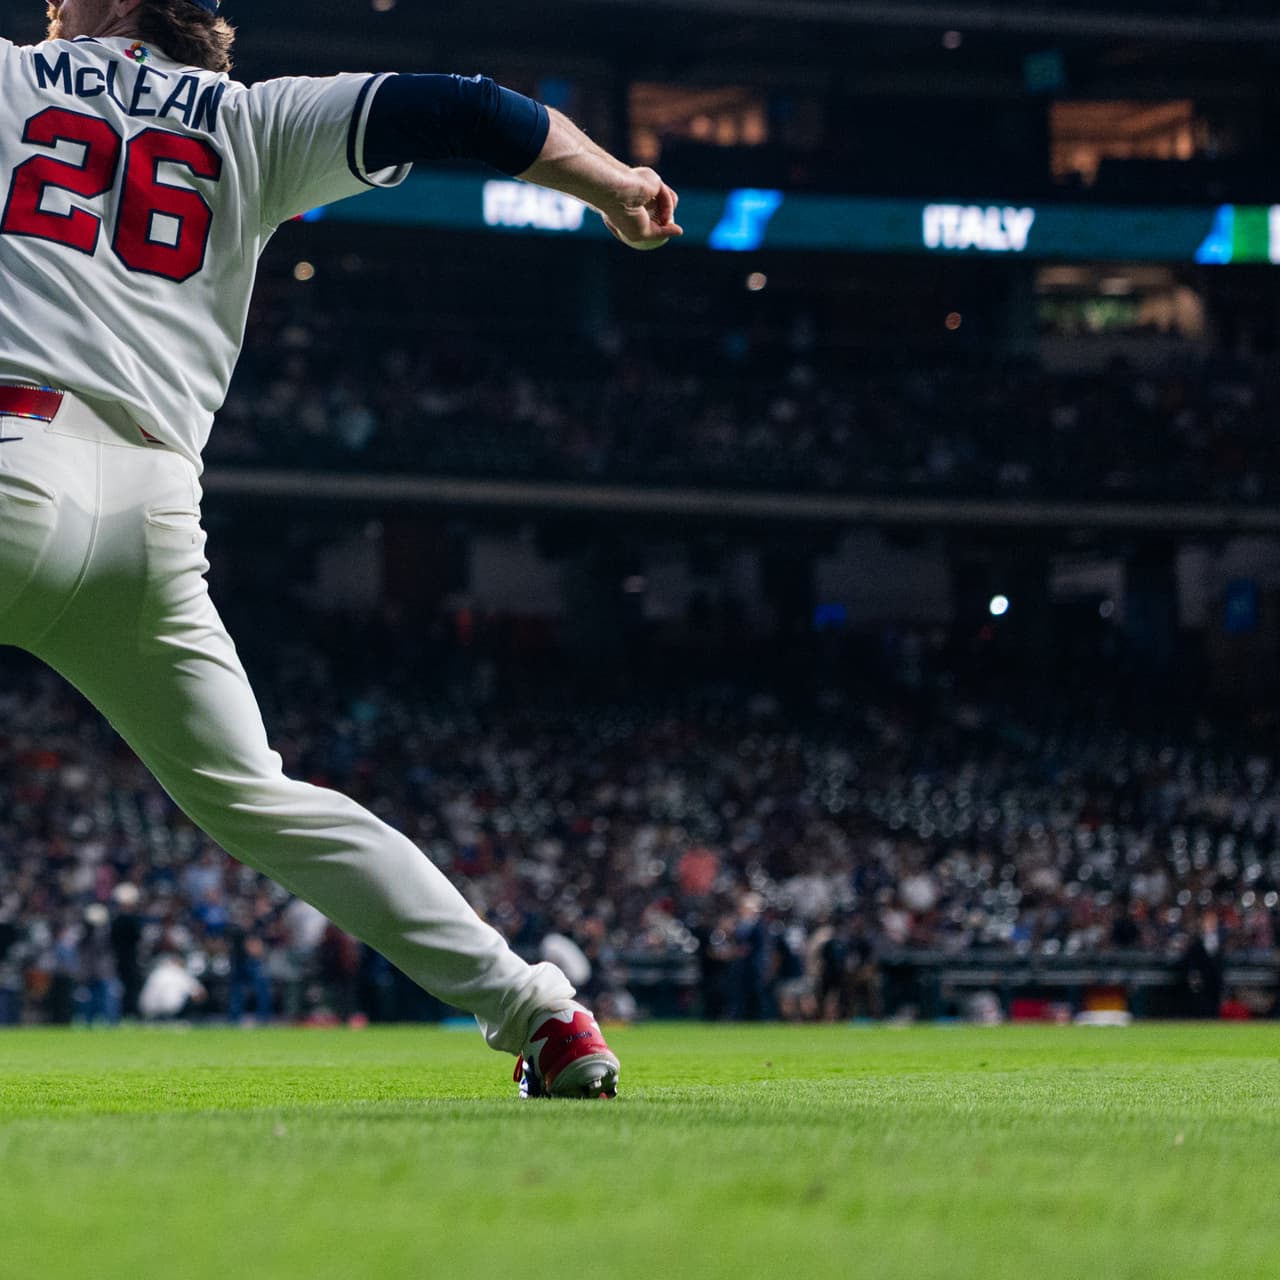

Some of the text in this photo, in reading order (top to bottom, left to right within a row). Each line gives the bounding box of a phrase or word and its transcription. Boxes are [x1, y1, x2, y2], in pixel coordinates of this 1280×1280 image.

[34, 52, 225, 133] McLEAN
[0, 106, 223, 283] 26
[922, 204, 1035, 251] ITALY
